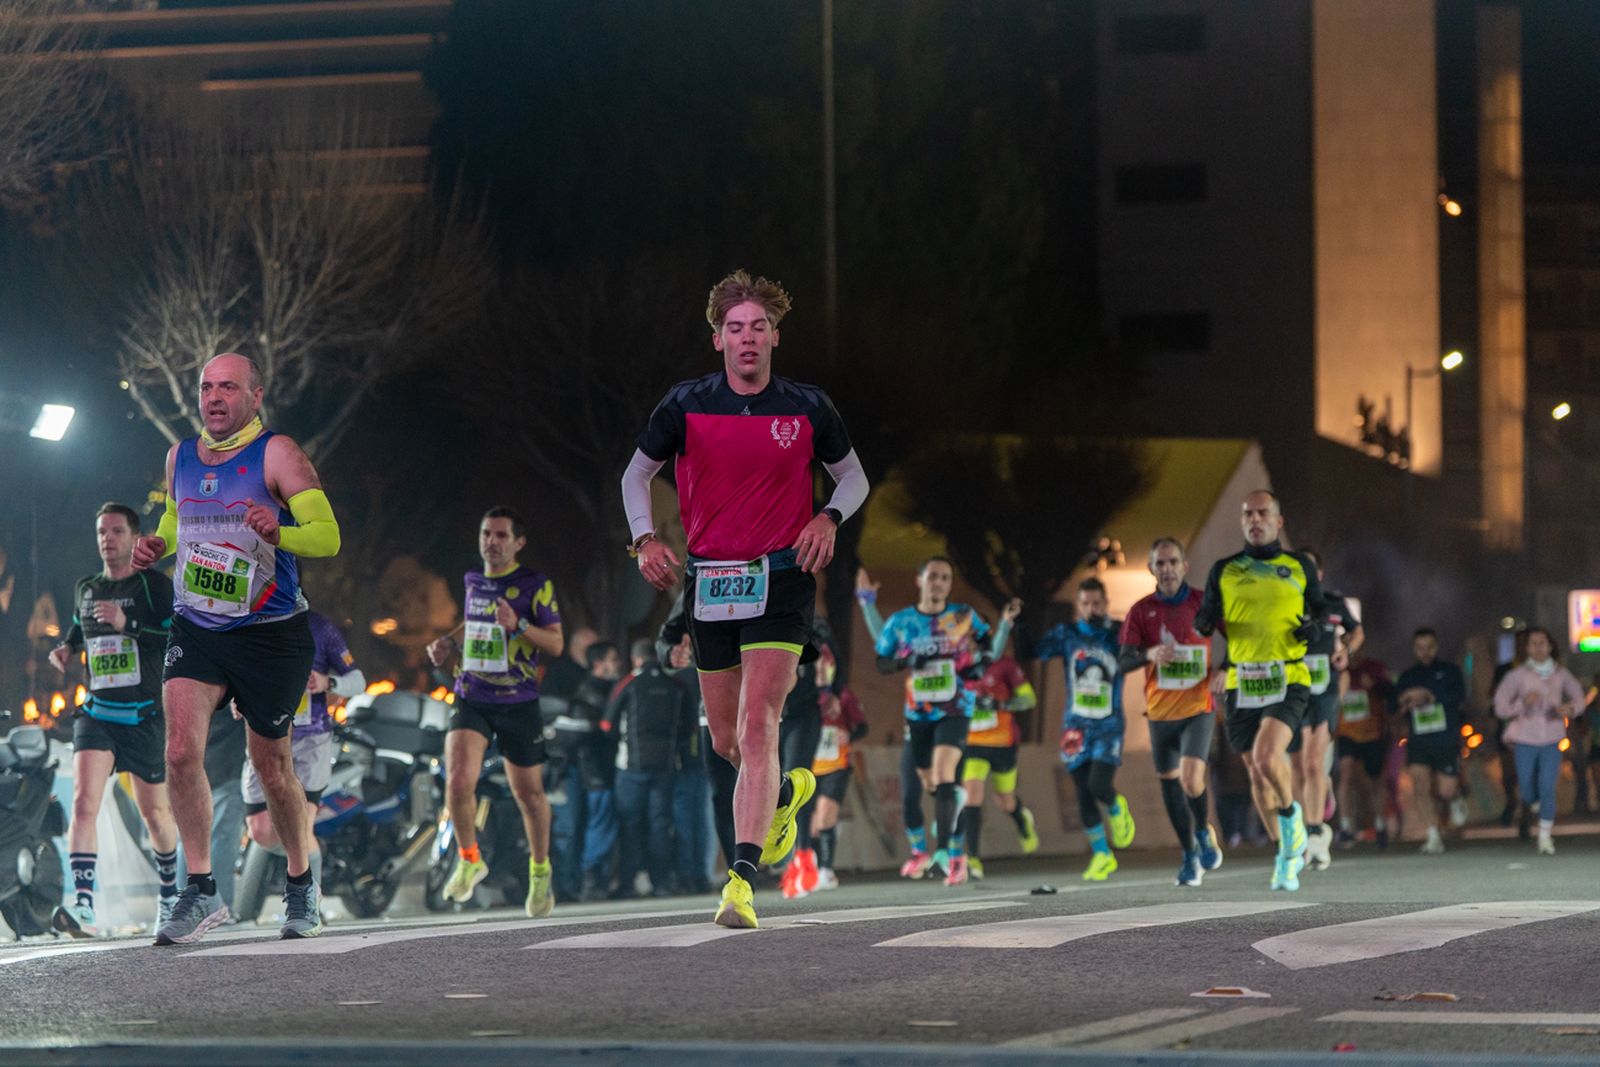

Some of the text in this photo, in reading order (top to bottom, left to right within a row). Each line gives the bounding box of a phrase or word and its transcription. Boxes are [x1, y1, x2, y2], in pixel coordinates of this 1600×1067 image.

[191, 555, 204, 567] SAN
[200, 549, 221, 561] NOCHE
[221, 555, 230, 563] DE
[194, 566, 237, 595] 1588
[709, 576, 756, 598] 8232
[95, 653, 128, 671] 2528
